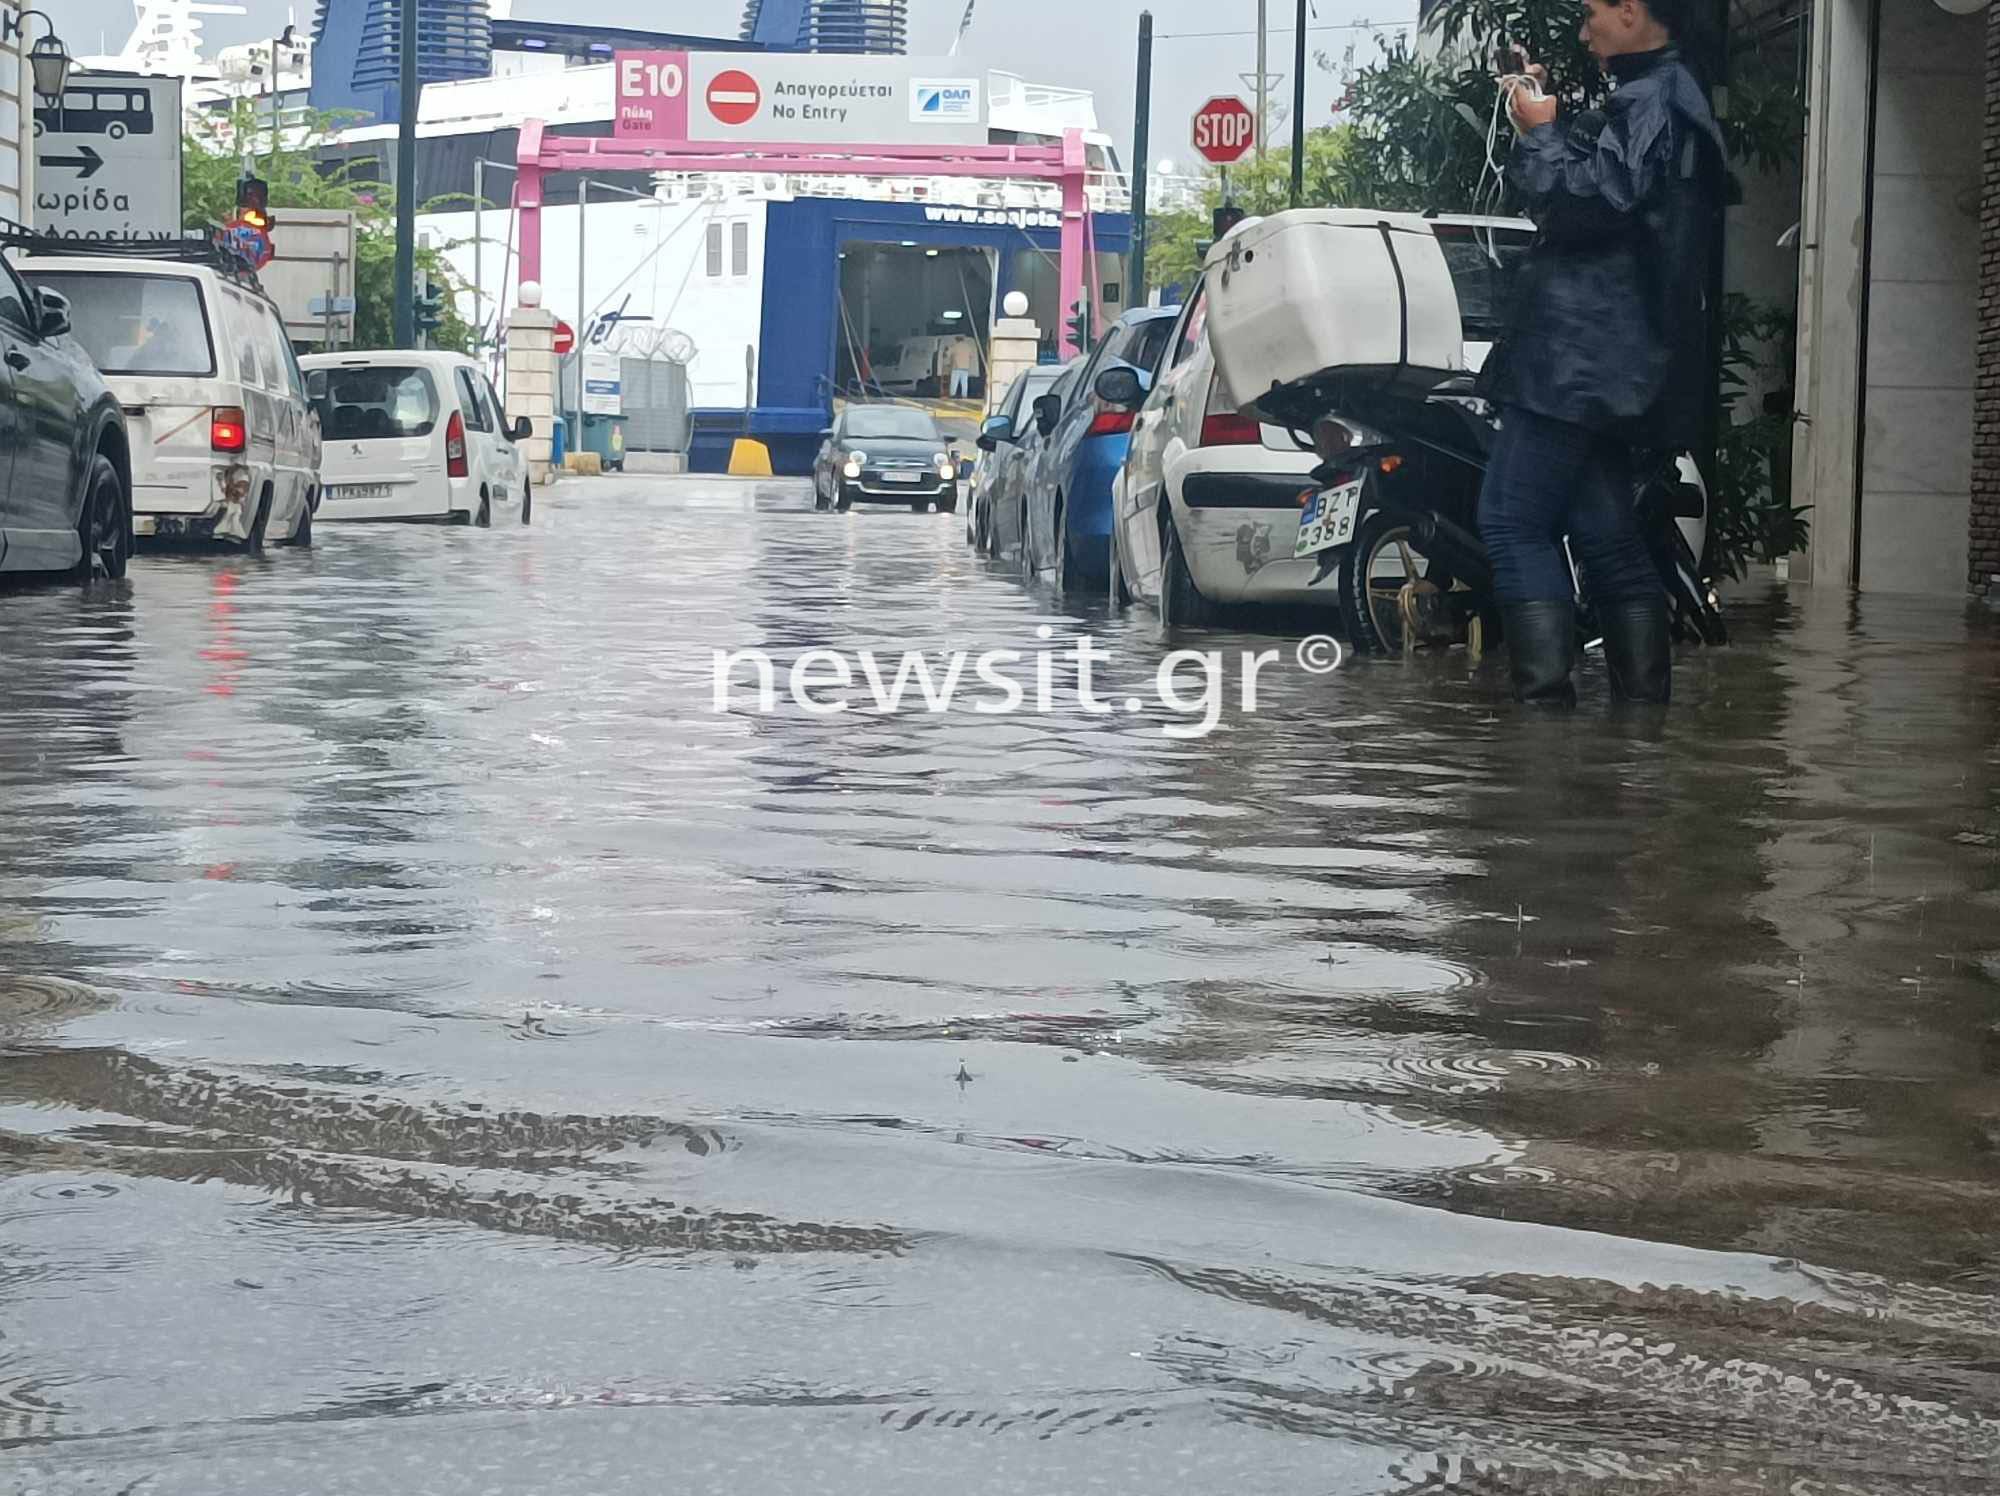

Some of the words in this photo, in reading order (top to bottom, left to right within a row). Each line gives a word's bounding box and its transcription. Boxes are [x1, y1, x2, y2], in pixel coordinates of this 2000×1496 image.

[622, 60, 683, 97] E10
[774, 79, 893, 99] Απαγορεύεται
[773, 104, 796, 119] No
[803, 104, 848, 122] Entry
[1196, 112, 1251, 148] STOP
[33, 185, 130, 216] ωρίδα
[1310, 516, 1350, 546] 388
